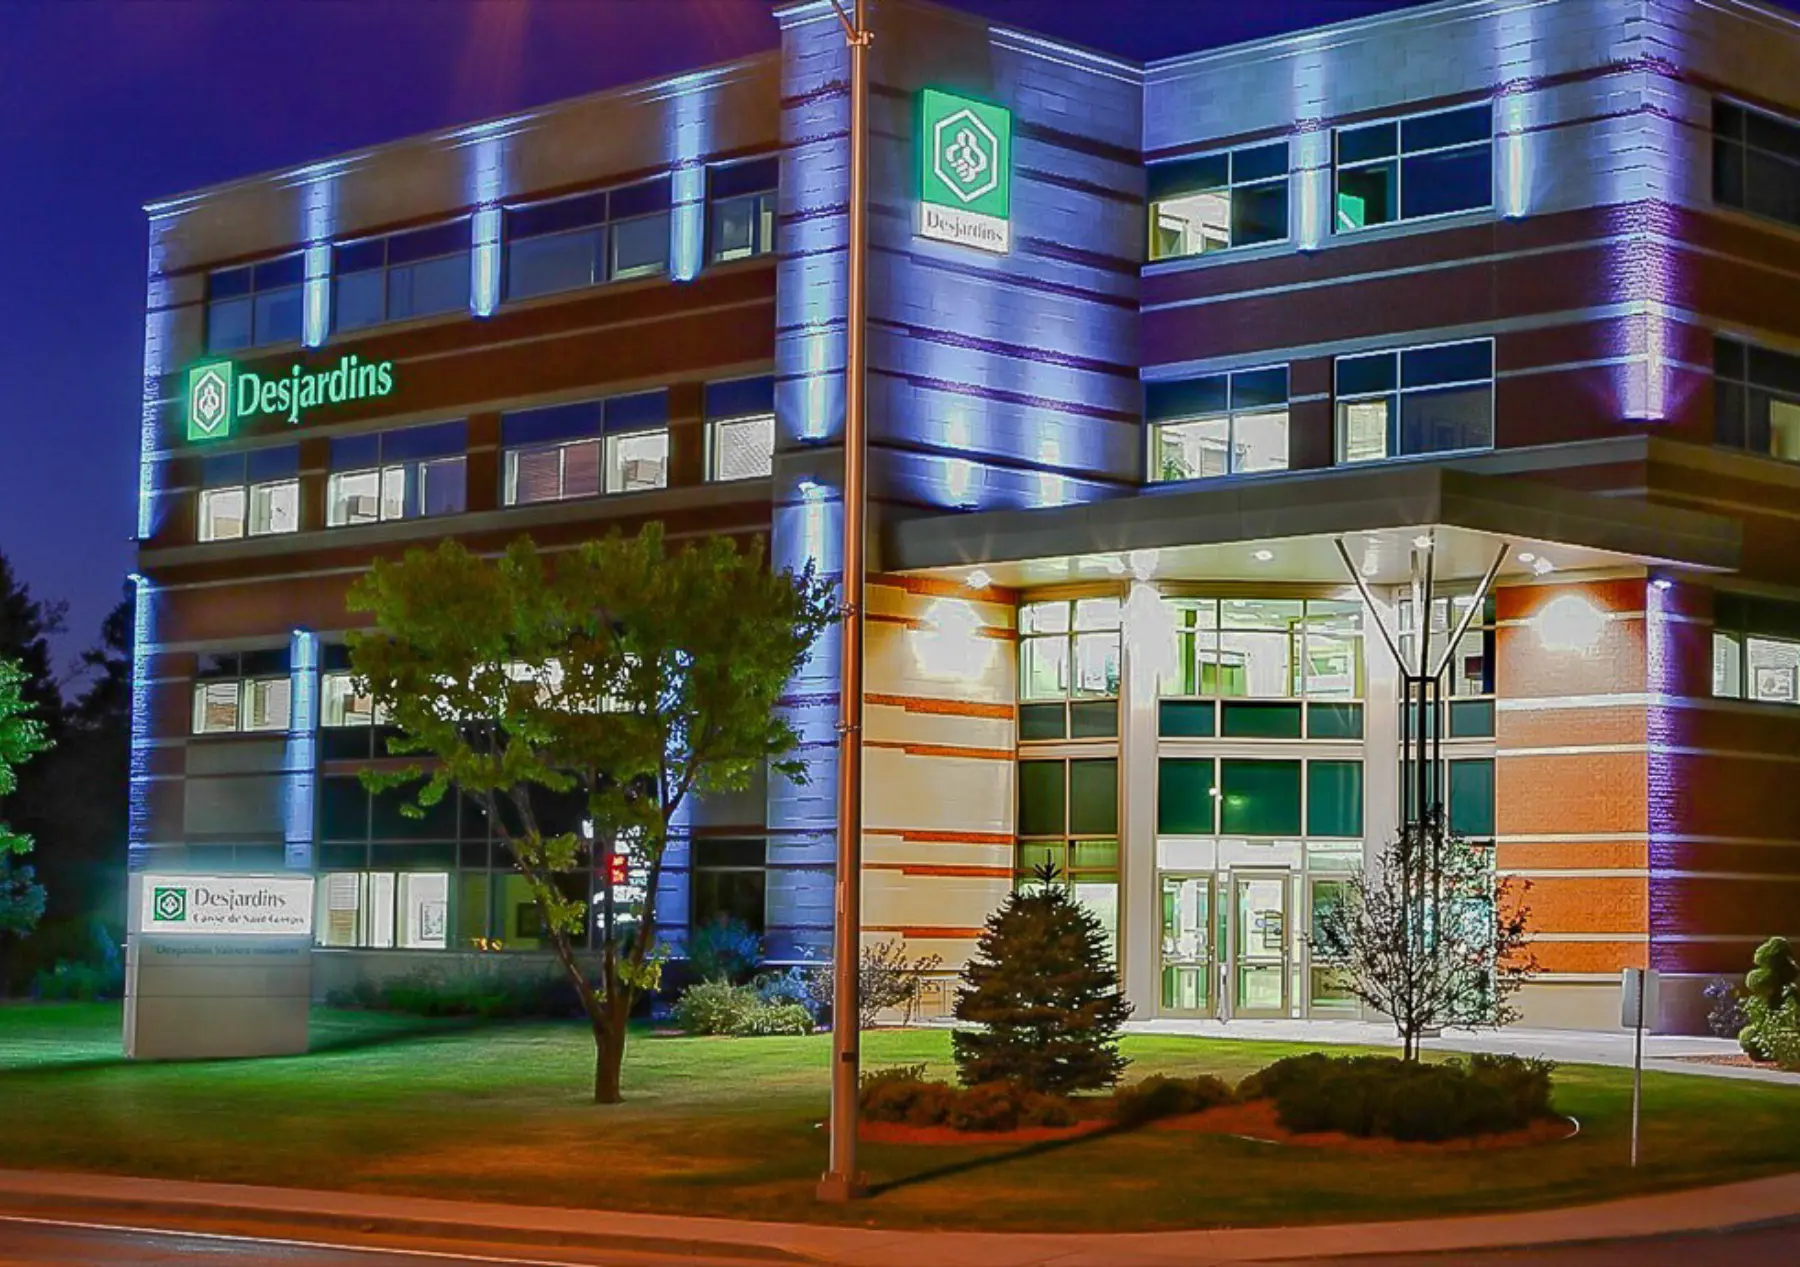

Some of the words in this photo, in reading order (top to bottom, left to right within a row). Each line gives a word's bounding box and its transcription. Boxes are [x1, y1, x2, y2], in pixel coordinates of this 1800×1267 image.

[927, 210, 1003, 241] Desjardins
[237, 355, 393, 423] Desjardins
[194, 888, 286, 909] Desjardins
